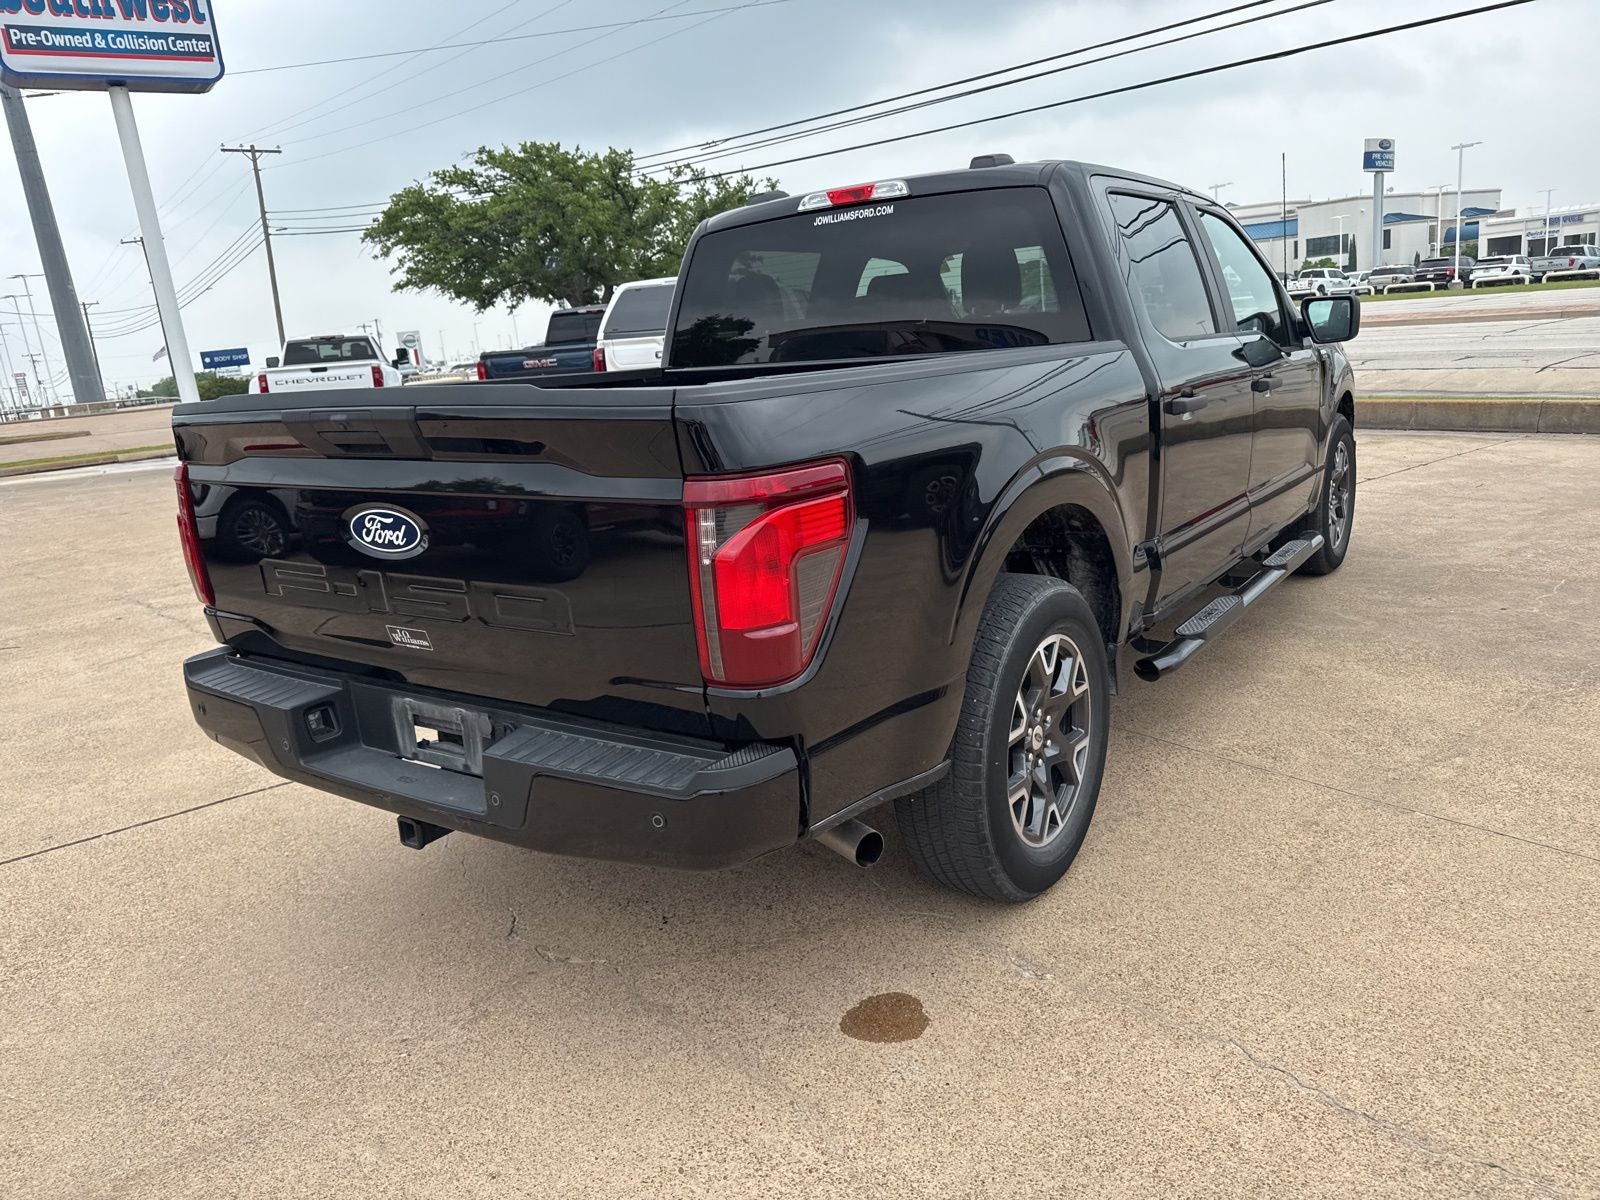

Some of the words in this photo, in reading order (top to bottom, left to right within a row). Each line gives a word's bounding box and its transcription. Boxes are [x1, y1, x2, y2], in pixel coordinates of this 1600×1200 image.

[9, 28, 92, 48] Pre-Owned
[94, 32, 106, 49] &
[107, 33, 167, 51] Collision
[168, 36, 211, 53] Center
[813, 205, 894, 227] JOWILLIAMSFORD.COM
[523, 358, 558, 369] GMC
[274, 373, 366, 386] CHEVROLET
[362, 514, 407, 546] Ford
